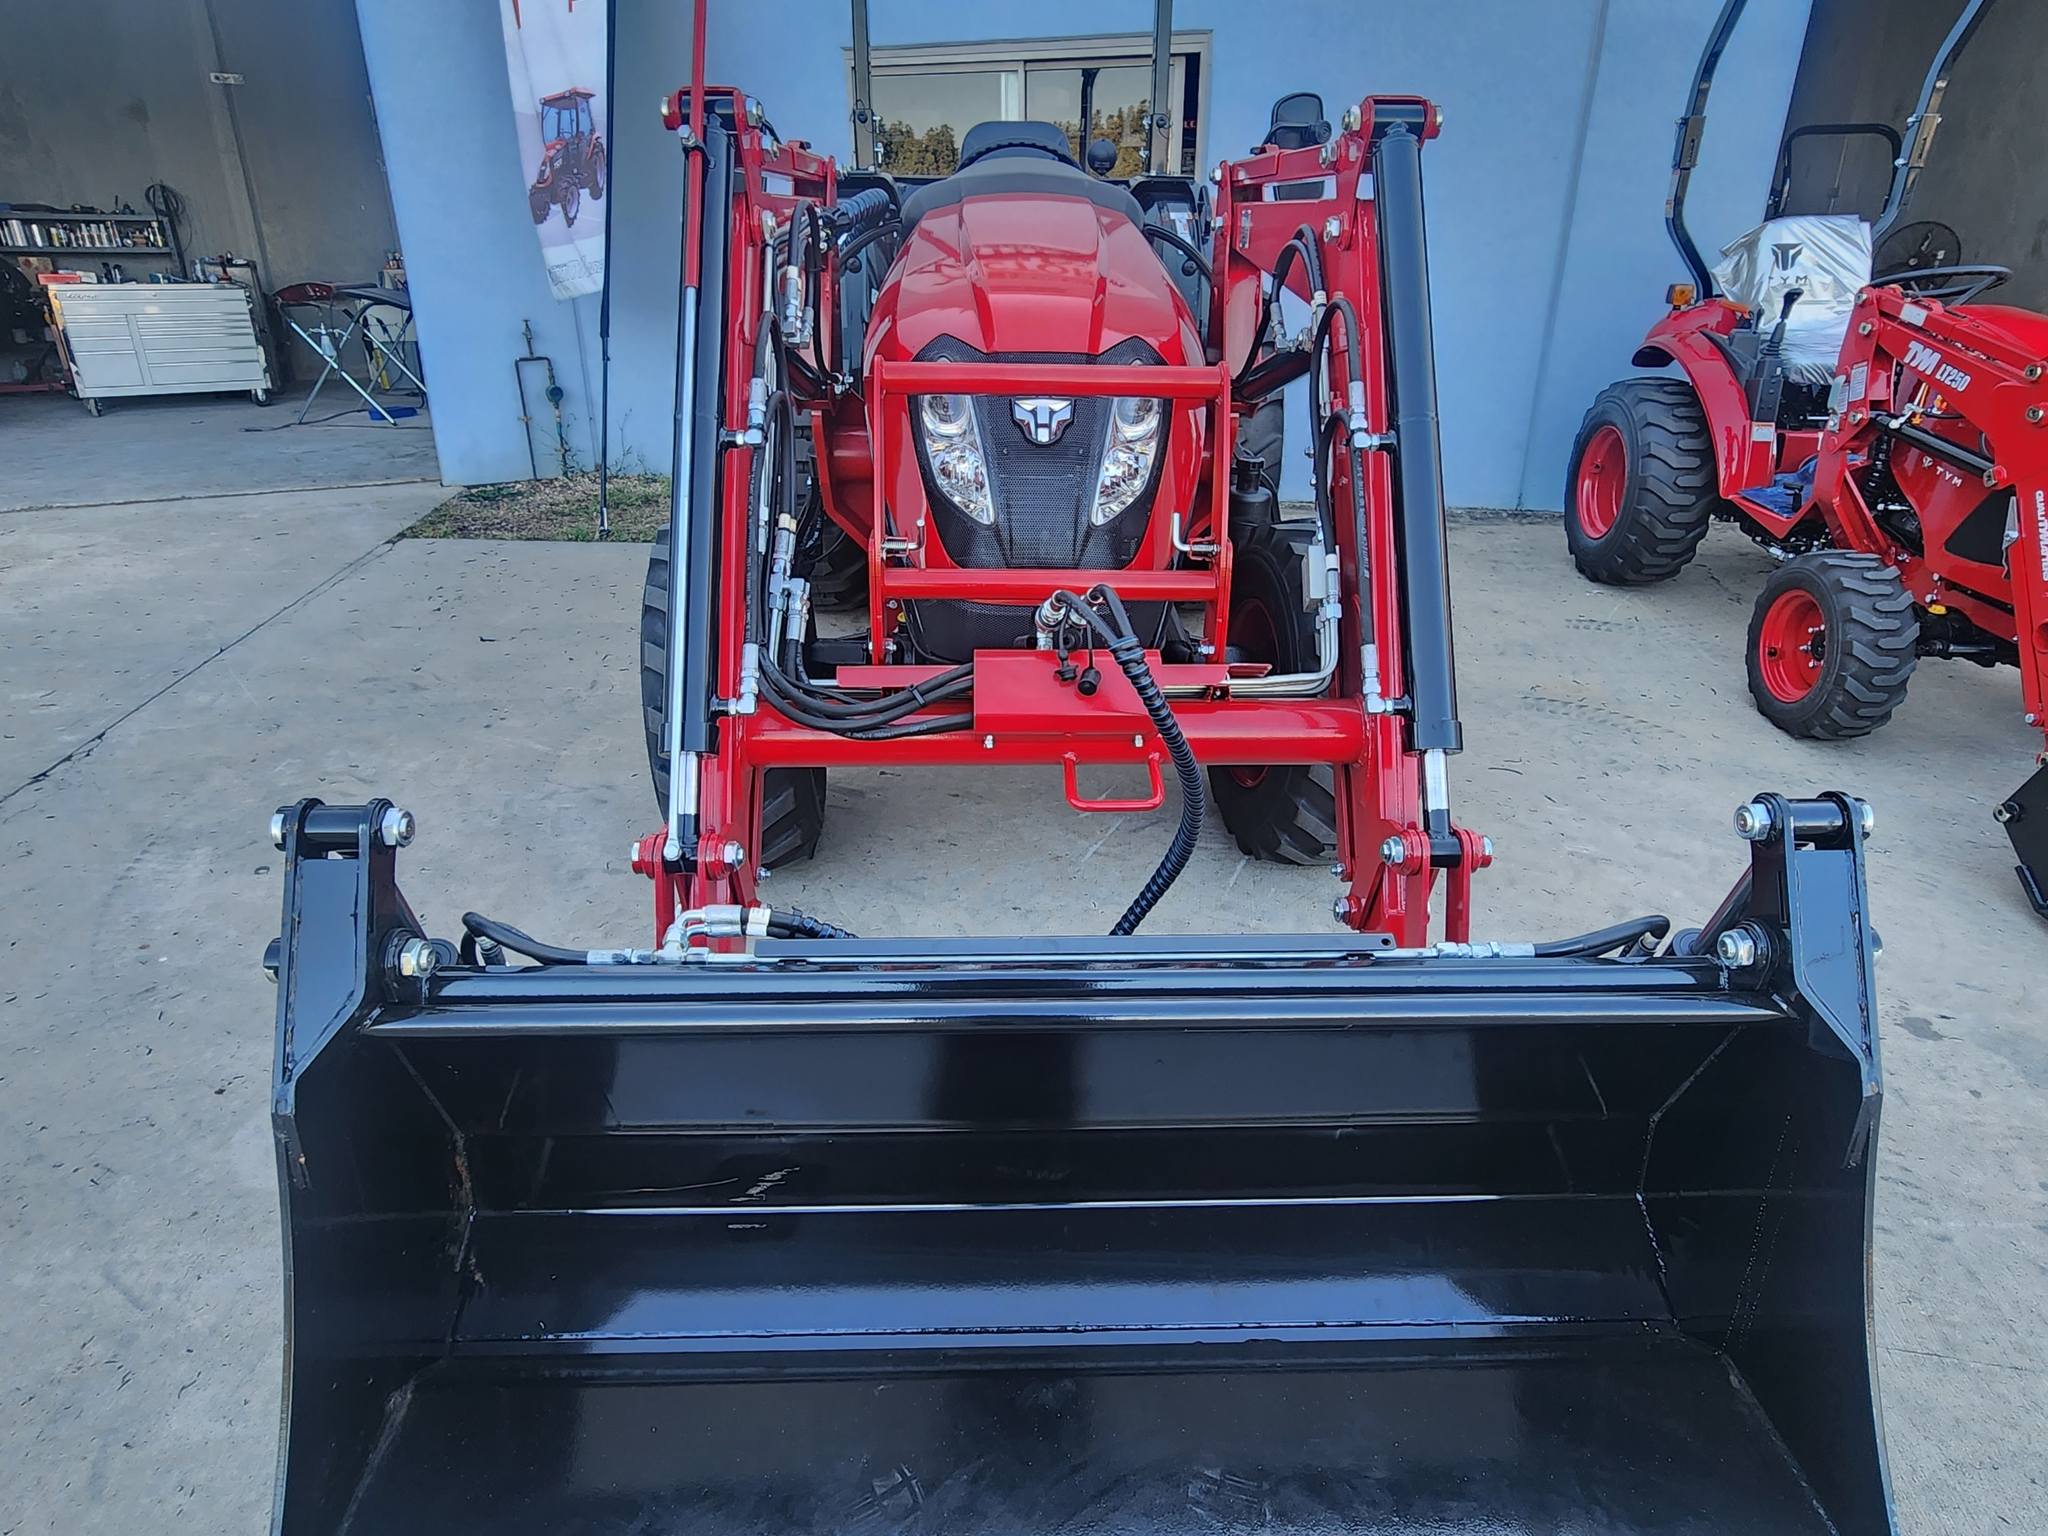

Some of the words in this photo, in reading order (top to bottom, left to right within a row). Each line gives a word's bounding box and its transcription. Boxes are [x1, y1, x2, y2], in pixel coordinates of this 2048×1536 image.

[1903, 340, 1941, 375] TYM
[1935, 363, 1971, 392] LT250
[1936, 466, 1962, 487] TYM
